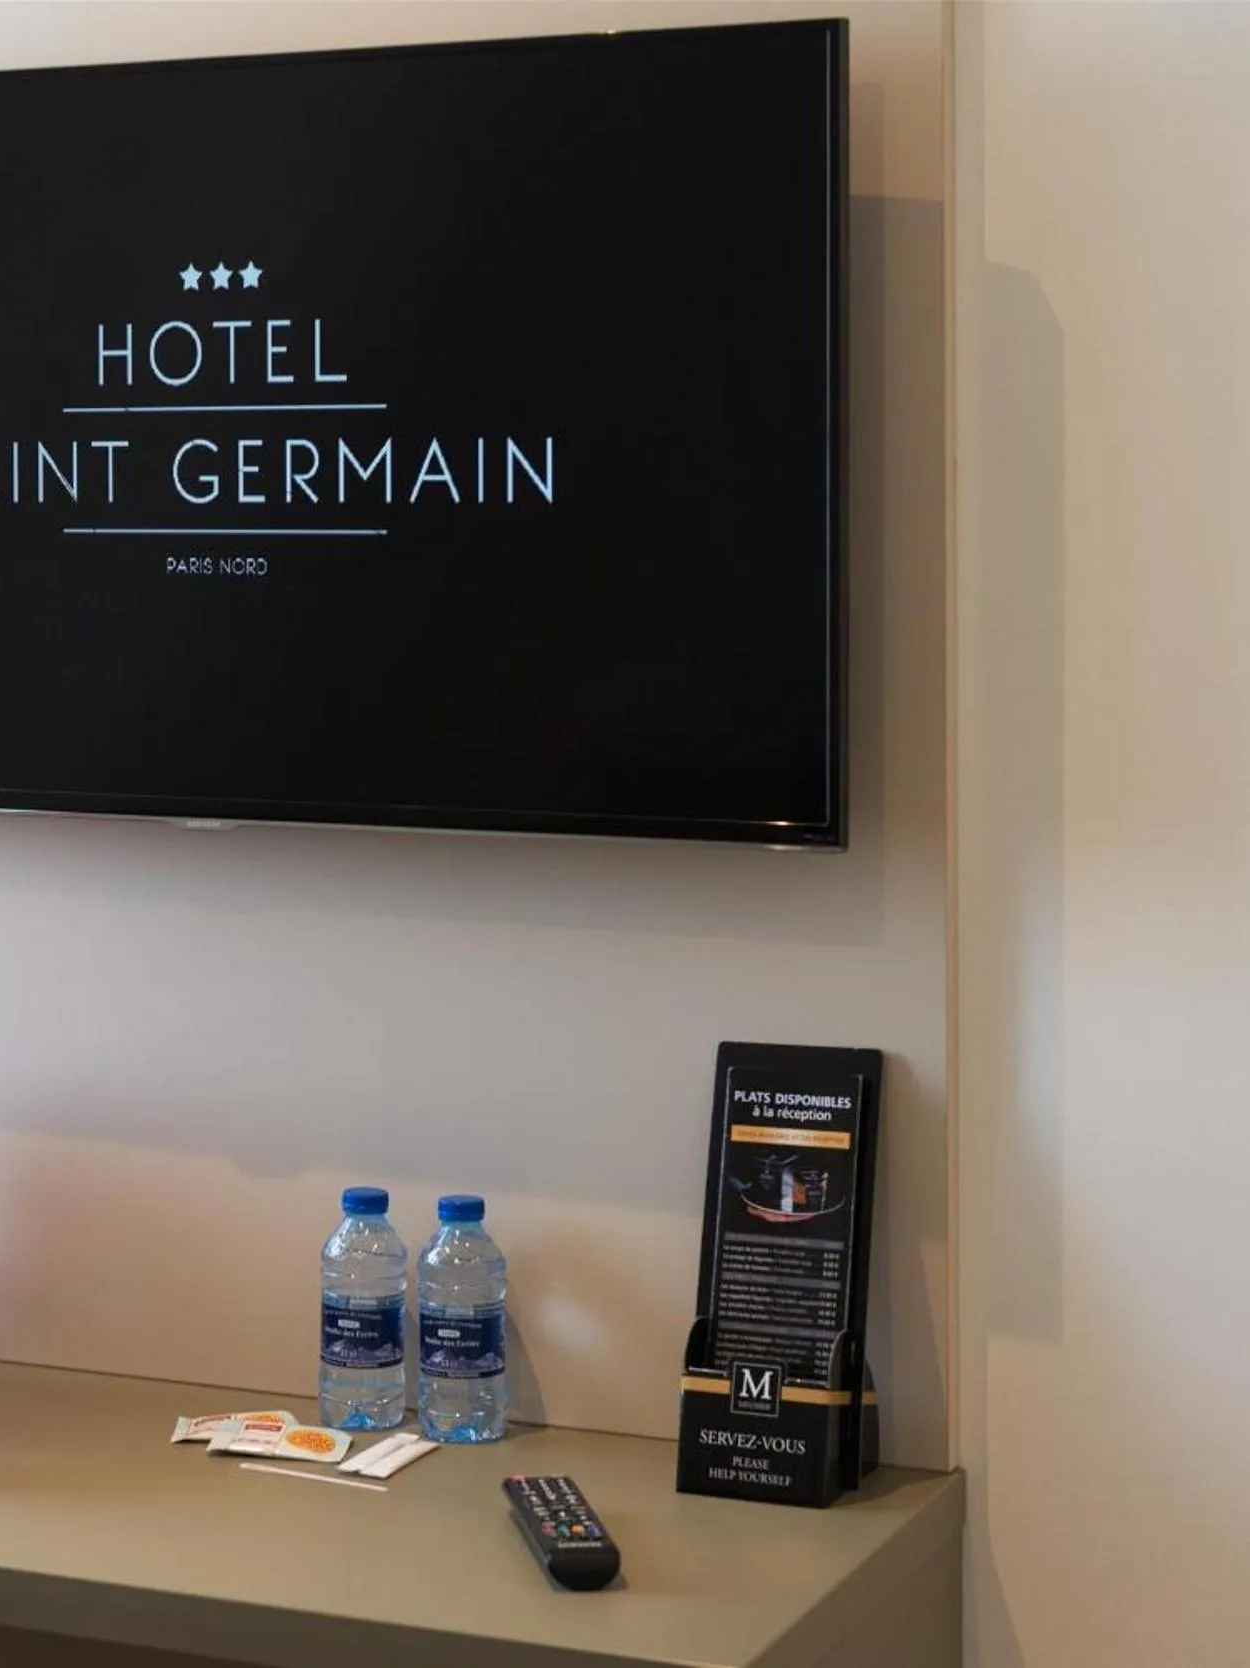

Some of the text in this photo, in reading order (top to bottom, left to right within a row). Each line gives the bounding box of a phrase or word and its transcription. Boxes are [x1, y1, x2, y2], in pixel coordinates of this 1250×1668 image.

[99, 319, 347, 386] HOTEL
[173, 437, 552, 503] GERMAIN
[166, 557, 268, 576] PARIS NORD
[734, 1090, 851, 1109] PLATS DISPONIBLES
[752, 1105, 832, 1122] à la réception
[739, 1368, 774, 1400] M
[699, 1428, 806, 1455] SERVEZ-VOUS
[732, 1456, 769, 1470] PLEASE
[709, 1467, 791, 1487] HELP YOURSELF
